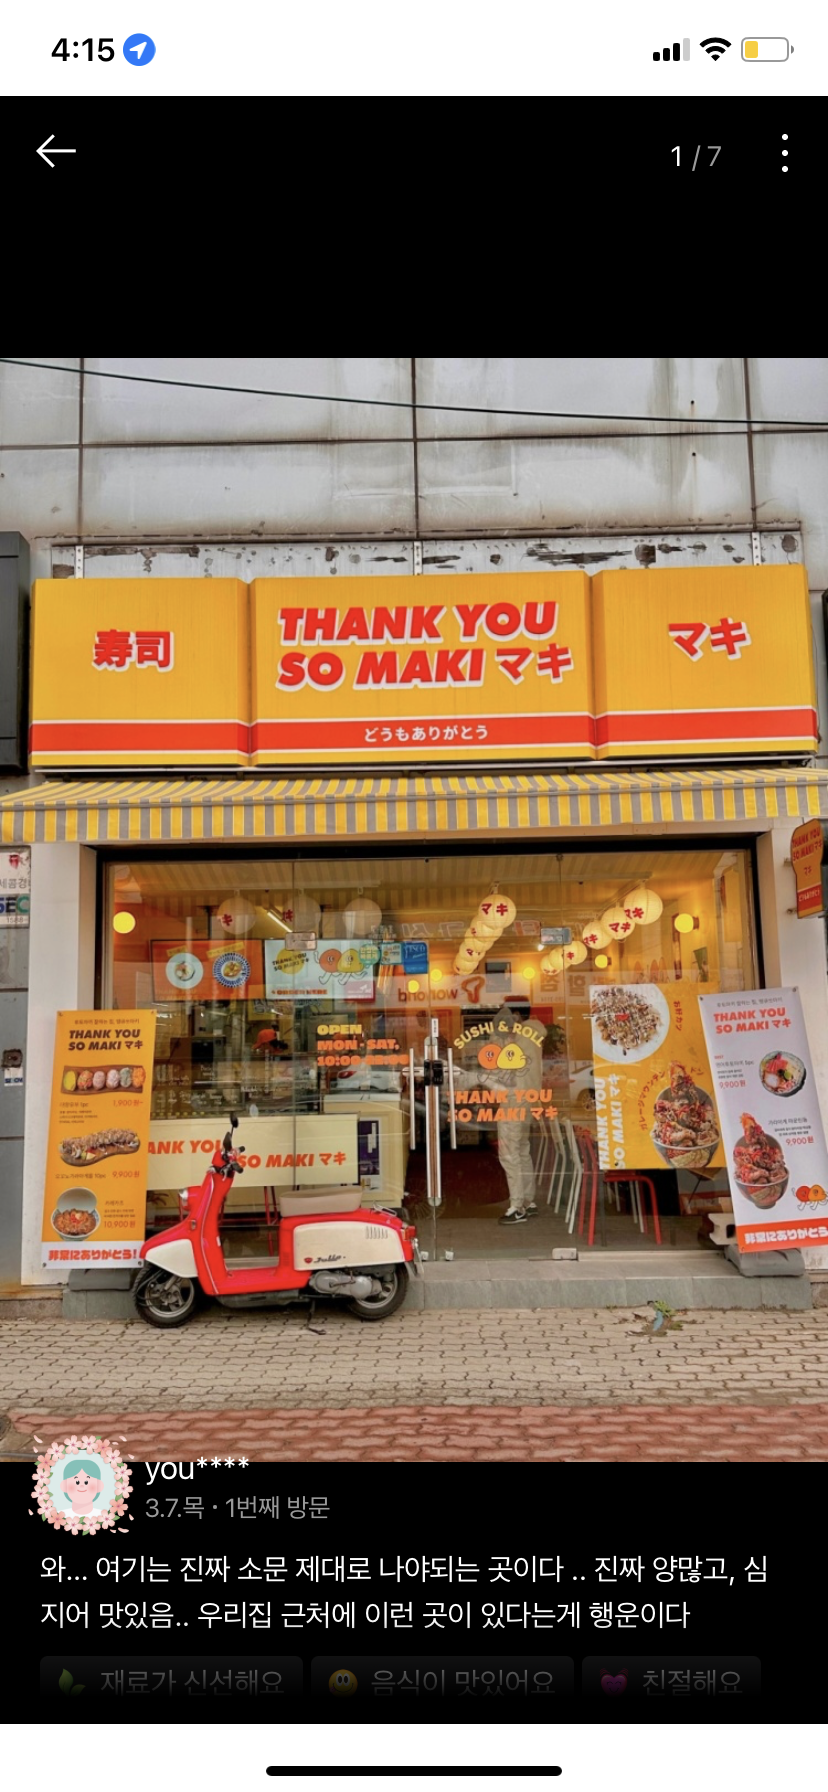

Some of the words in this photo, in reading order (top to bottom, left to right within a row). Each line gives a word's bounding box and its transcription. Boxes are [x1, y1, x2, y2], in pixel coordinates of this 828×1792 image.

[279, 605, 445, 644] THANK
[456, 601, 557, 638] YOU
[668, 617, 749, 658] マキ
[94, 629, 172, 668] 寿司
[277, 651, 343, 688] SO
[355, 648, 485, 687] MAKI
[495, 643, 573, 680] マキ
[363, 724, 489, 743] どうもありがとう
[481, 903, 509, 917] マキ
[608, 921, 632, 933] マキ
[714, 1009, 756, 1023] THANK
[759, 1007, 786, 1018] YOU
[69, 1029, 111, 1039] THANK
[115, 1029, 141, 1038] YOU
[453, 1022, 494, 1050] SUSHI
[497, 1020, 509, 1033] &
[512, 1022, 546, 1048] ROLL
[715, 1024, 733, 1035] SO
[736, 1020, 769, 1033] MAKI
[772, 1018, 791, 1029] マキ
[68, 1041, 85, 1051] SO
[88, 1041, 122, 1051] MAKI
[124, 1039, 143, 1050] マキ
[317, 1039, 358, 1051] MON
[366, 1038, 400, 1051] SAT,
[593, 1078, 607, 1112] YOU
[607, 1073, 621, 1098] マキ
[514, 1088, 553, 1103] YOU
[477, 1108, 526, 1122] MAKI
[530, 1105, 558, 1121] マキ
[609, 1101, 624, 1144] MAKI
[597, 1115, 611, 1170] THANK
[237, 1154, 261, 1169] SO
[265, 1153, 315, 1168] MAKI
[319, 1151, 347, 1166] マキ
[612, 1147, 626, 1170] SO
